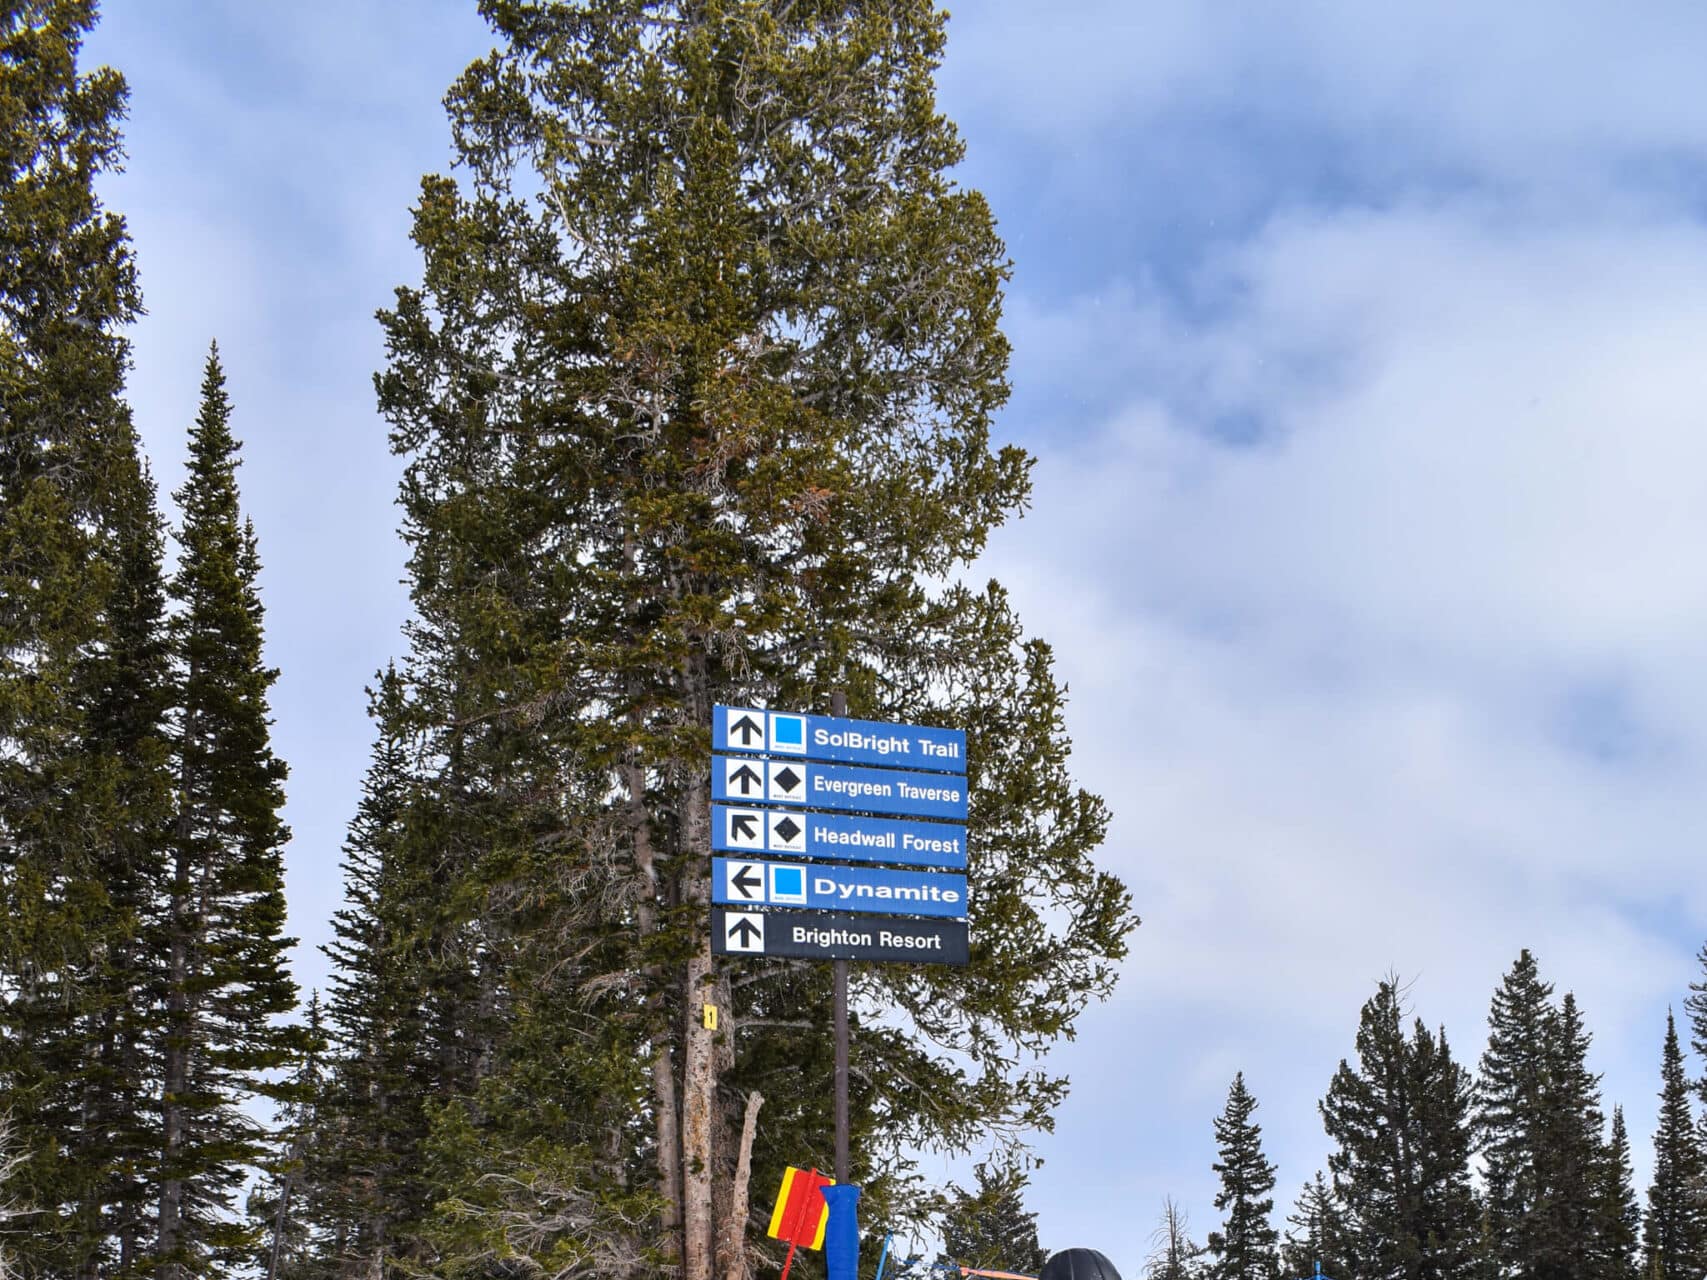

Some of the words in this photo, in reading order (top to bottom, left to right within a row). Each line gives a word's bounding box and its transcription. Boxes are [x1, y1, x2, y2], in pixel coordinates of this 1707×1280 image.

[814, 729, 910, 755] SolBright
[918, 740, 959, 758] Trail
[814, 776, 891, 798] Evergreen
[897, 782, 960, 802] Traverse
[814, 827, 895, 849] Headwall
[903, 835, 960, 854] Forest
[814, 879, 960, 903] Dynamite
[793, 927, 872, 946] Brighton
[879, 932, 942, 950] Resort
